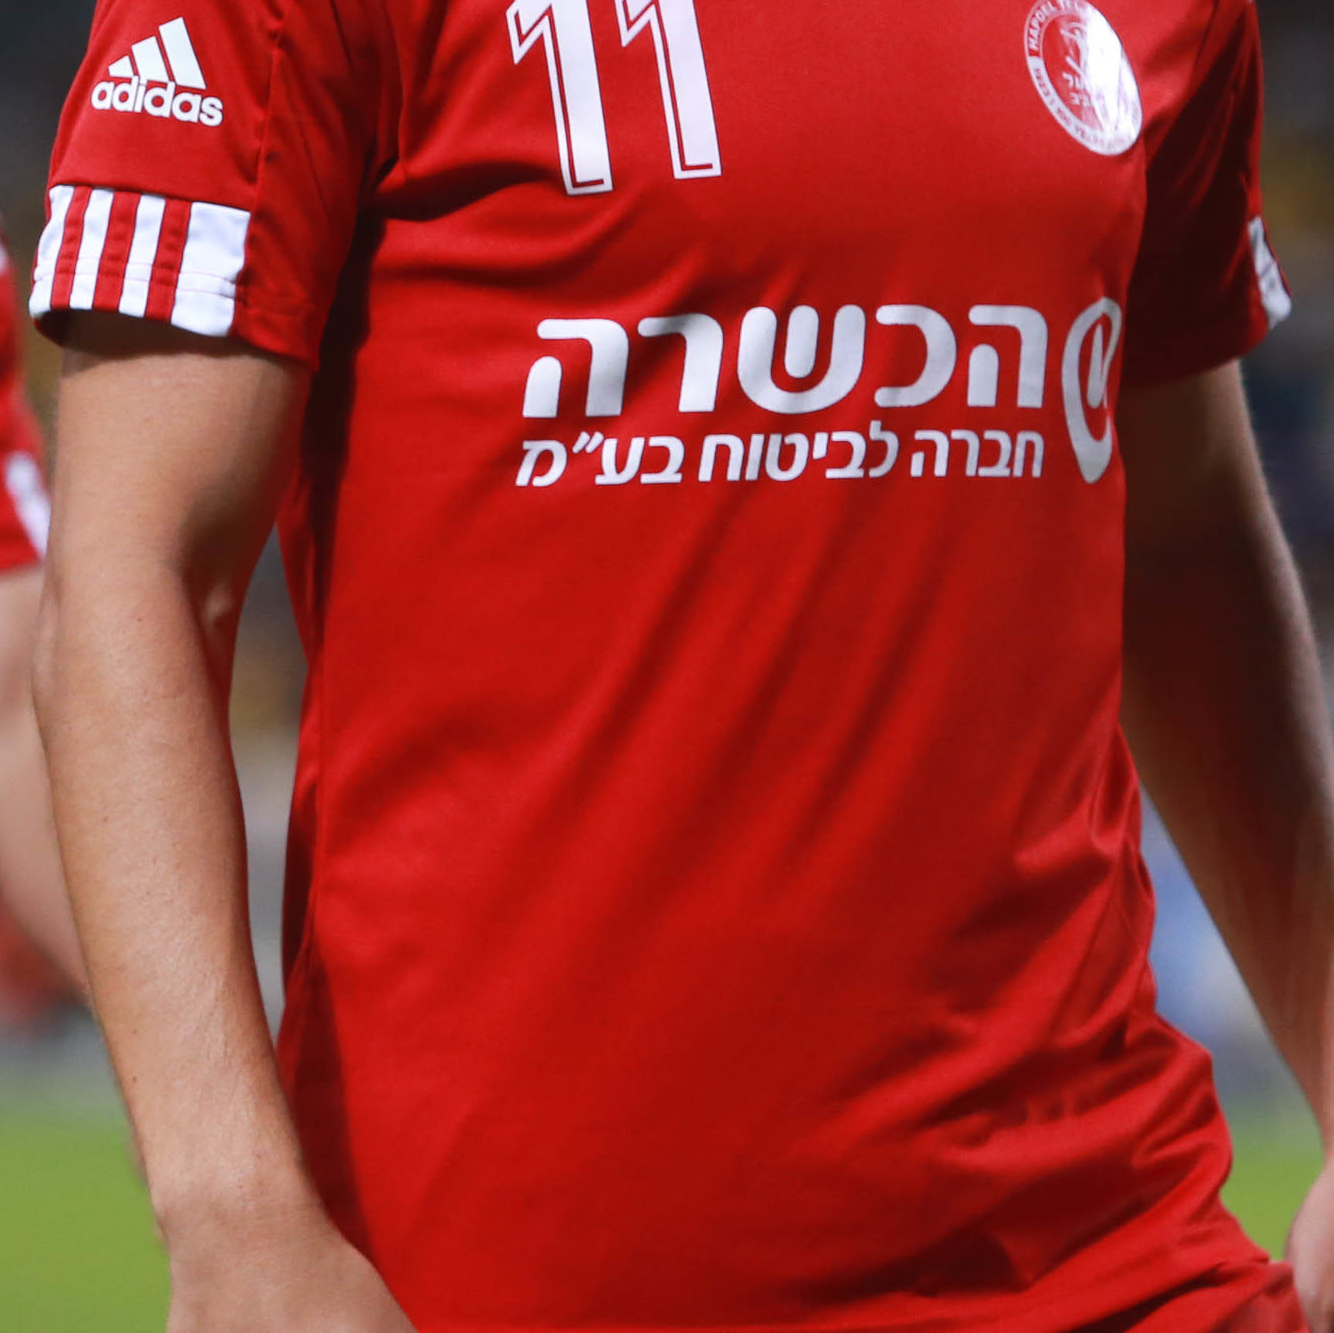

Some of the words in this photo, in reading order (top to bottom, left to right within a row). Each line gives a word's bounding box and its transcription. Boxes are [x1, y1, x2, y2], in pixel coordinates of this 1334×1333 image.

[91, 75, 224, 127] adidas
[522, 303, 1049, 419] הכשרה
[698, 419, 900, 482] לביטוח
[910, 429, 1045, 479] חברה
